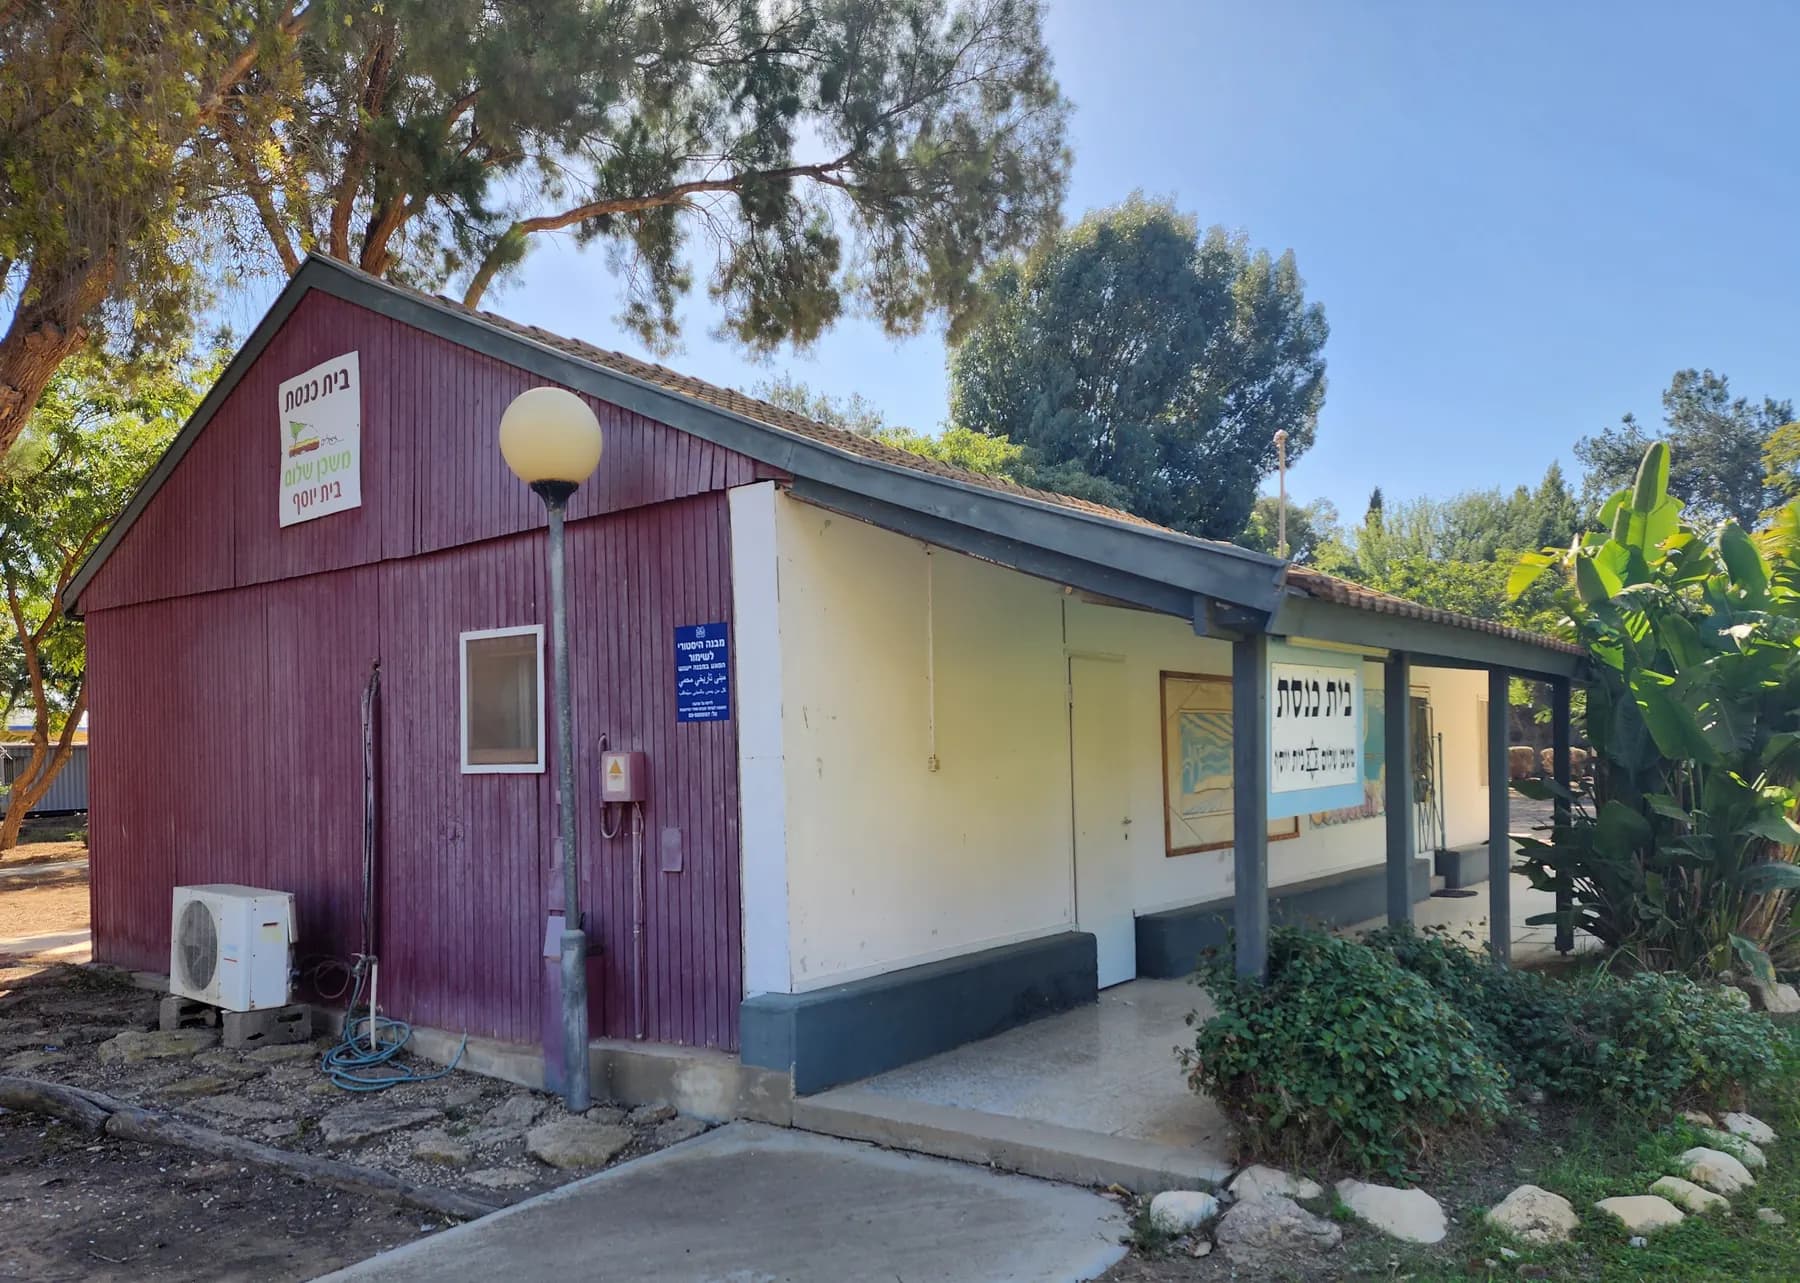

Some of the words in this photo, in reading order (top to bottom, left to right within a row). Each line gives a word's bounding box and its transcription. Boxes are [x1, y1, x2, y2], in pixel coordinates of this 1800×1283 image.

[285, 379, 319, 412] כנסת
[322, 368, 350, 397] בית
[285, 461, 313, 487] שלום
[316, 451, 352, 482] משכן
[293, 490, 317, 515] יוסף
[320, 480, 342, 503] בית
[677, 641, 704, 650] היסטורי
[689, 651, 714, 661] לשימור
[705, 639, 725, 648] מבנה
[1277, 676, 1320, 718] כנסת
[1326, 677, 1352, 717] בית
